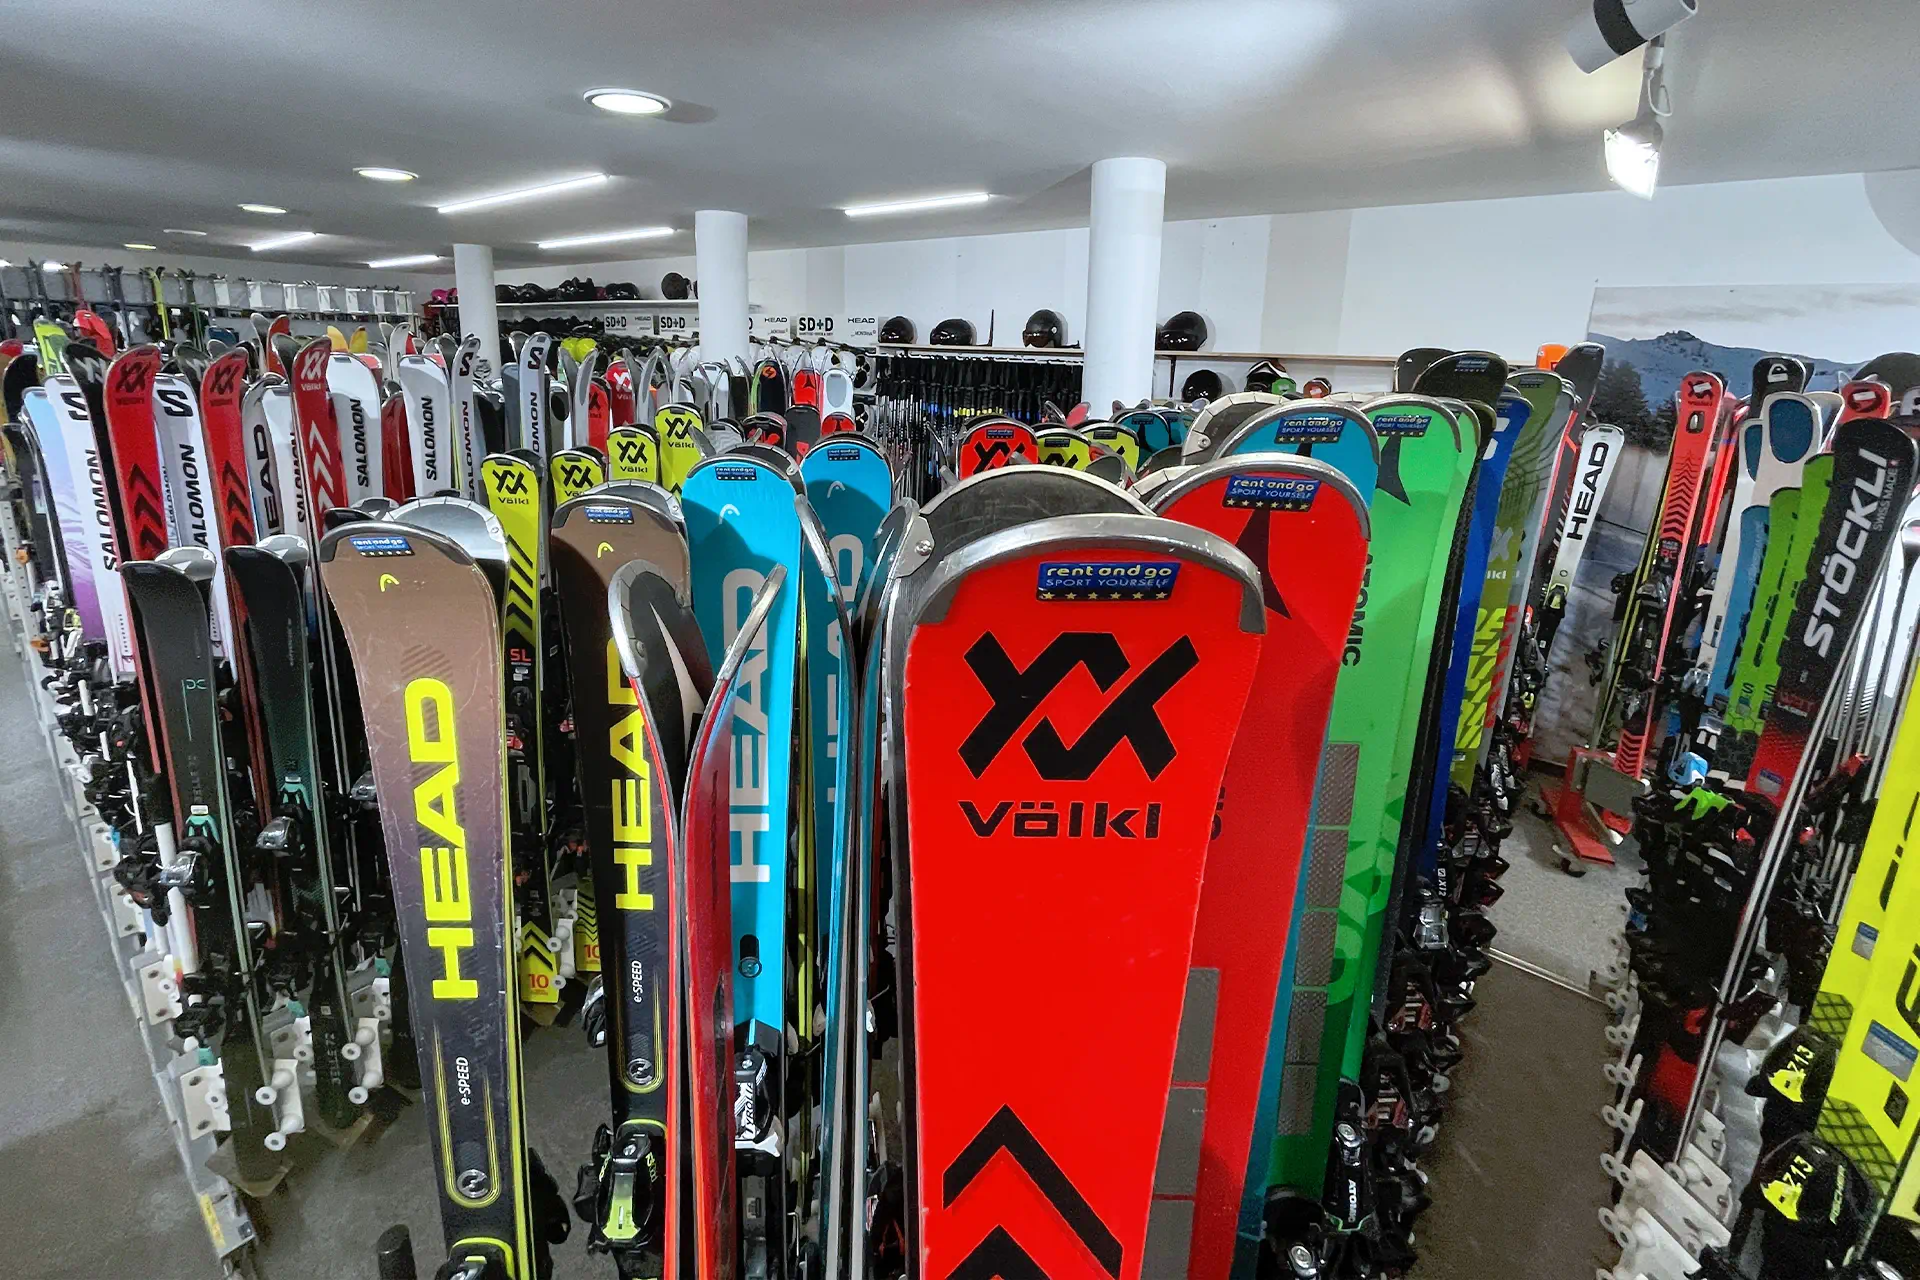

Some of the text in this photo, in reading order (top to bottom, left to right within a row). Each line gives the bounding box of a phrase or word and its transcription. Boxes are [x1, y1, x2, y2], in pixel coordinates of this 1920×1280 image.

[605, 316, 627, 328] SD+D
[660, 316, 686, 329] SD+D
[798, 317, 834, 332] SD+D
[530, 391, 540, 453] OMON
[1307, 418, 1329, 426] and
[1329, 420, 1343, 428] go
[350, 398, 370, 488] SALOMON
[421, 397, 438, 481] SALOMON
[253, 424, 284, 536] EAD
[619, 465, 648, 473] Völkl
[179, 443, 209, 549] ALOMON
[1230, 488, 1311, 499] SPORT YOURSELF
[1233, 479, 1315, 492] rent and go
[1566, 441, 1609, 541] HEAD
[498, 496, 530, 505] Völkl
[1803, 448, 1888, 658] STÖCKLI
[1046, 578, 1169, 589] SPORT YOURSELF
[1047, 564, 1173, 579] rent and go
[510, 648, 532, 662] SL
[958, 801, 1162, 839] Völkl
[404, 677, 479, 1000] HEAD
[528, 973, 550, 989] 10
[631, 960, 643, 1004] e-SPEED
[460, 1056, 472, 1106] e-SPEED
[1347, 1179, 1357, 1223] ATOMIC
